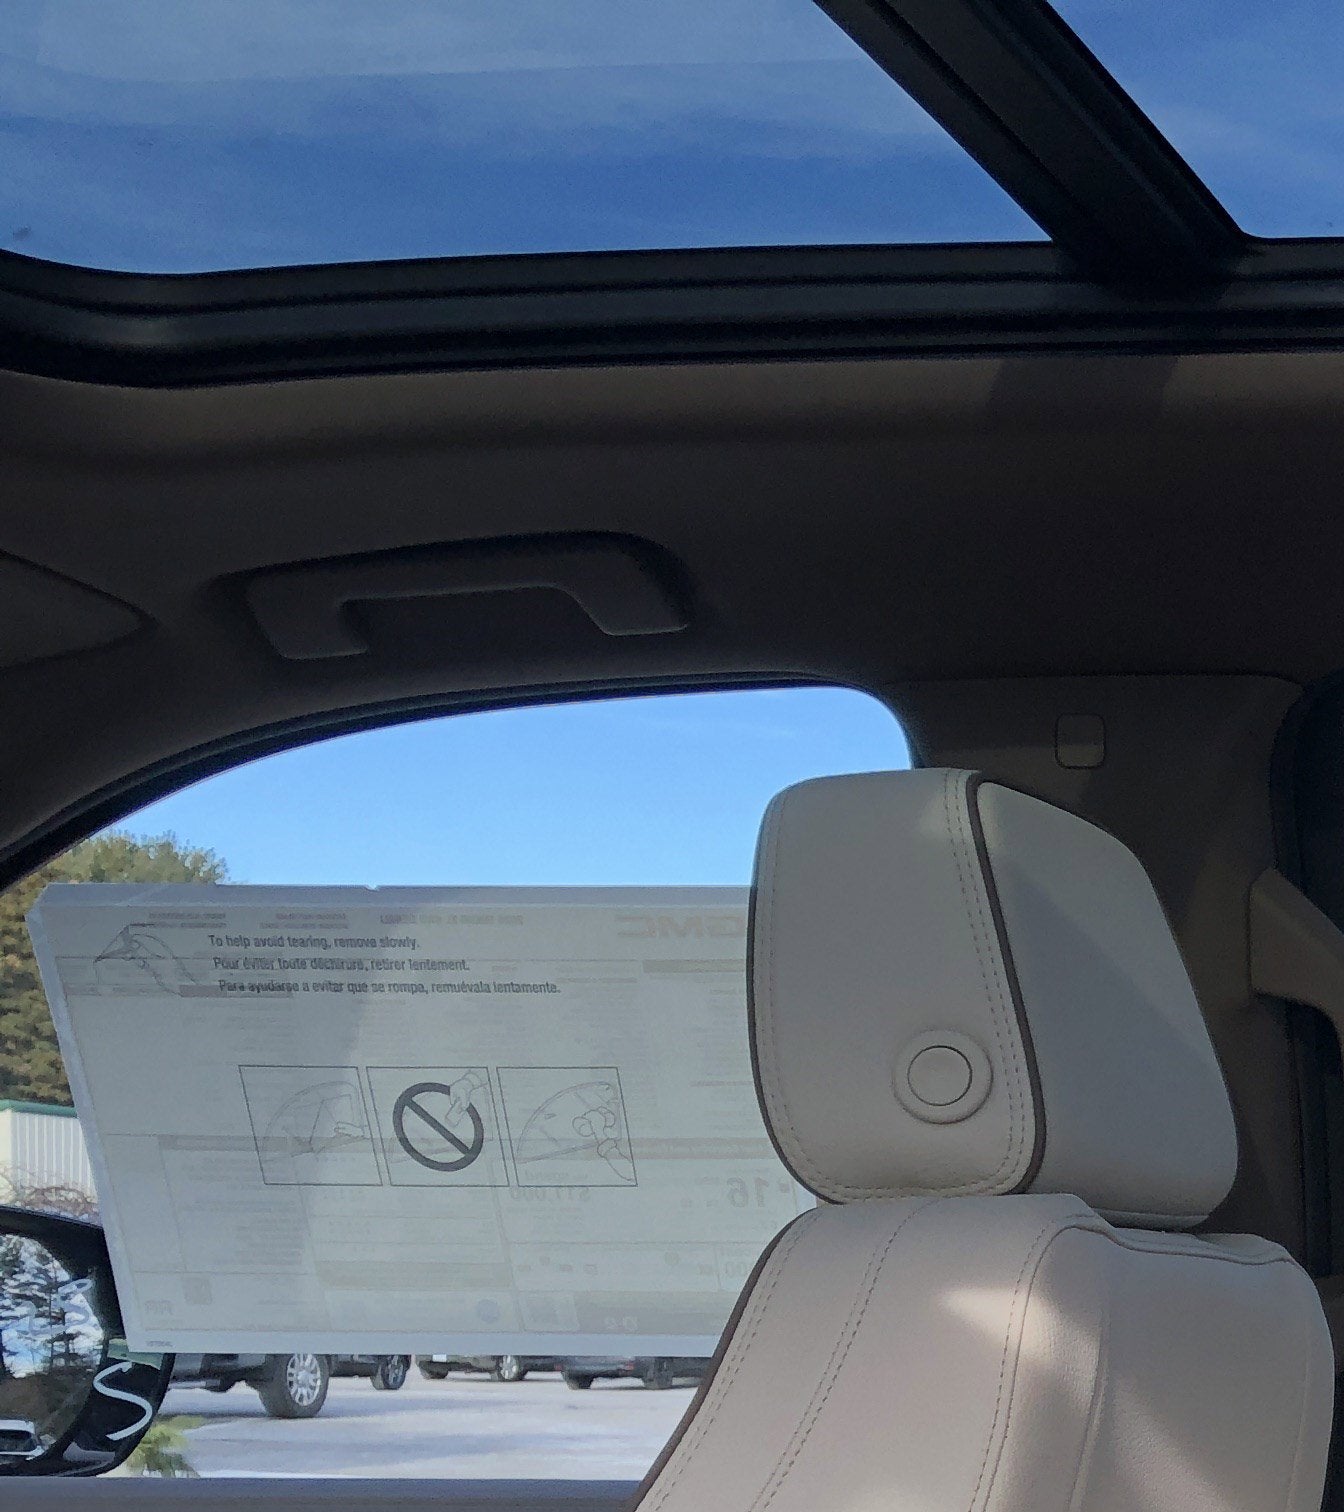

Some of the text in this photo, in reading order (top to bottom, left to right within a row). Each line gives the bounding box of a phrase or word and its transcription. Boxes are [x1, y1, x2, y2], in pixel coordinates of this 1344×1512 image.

[208, 934, 420, 950] To help avoid tearing, remove slowly.
[213, 957, 240, 970] Pour
[277, 957, 307, 970] toute
[370, 958, 406, 971] retirer
[408, 958, 470, 971] lentement.
[218, 979, 561, 995] Para ayudarse a evitar que se rompa, remuévala lentamente.
